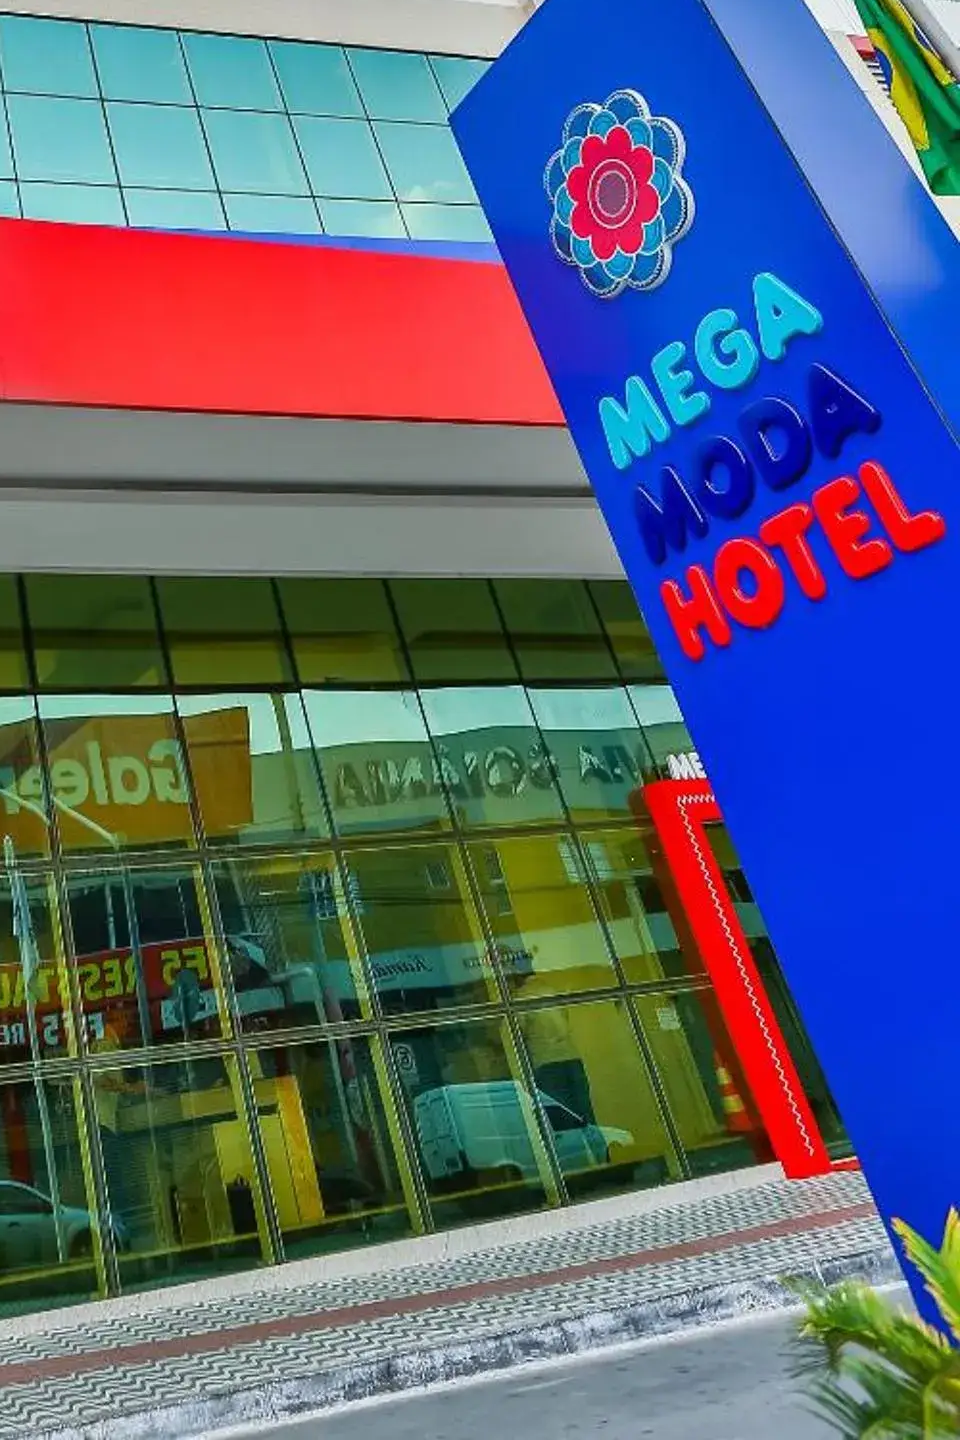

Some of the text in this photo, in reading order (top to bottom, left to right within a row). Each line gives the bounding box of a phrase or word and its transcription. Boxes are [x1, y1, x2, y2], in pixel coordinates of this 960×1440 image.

[598, 272, 823, 469] MEGA
[636, 363, 882, 564] MODA
[660, 460, 945, 661] HOTEL
